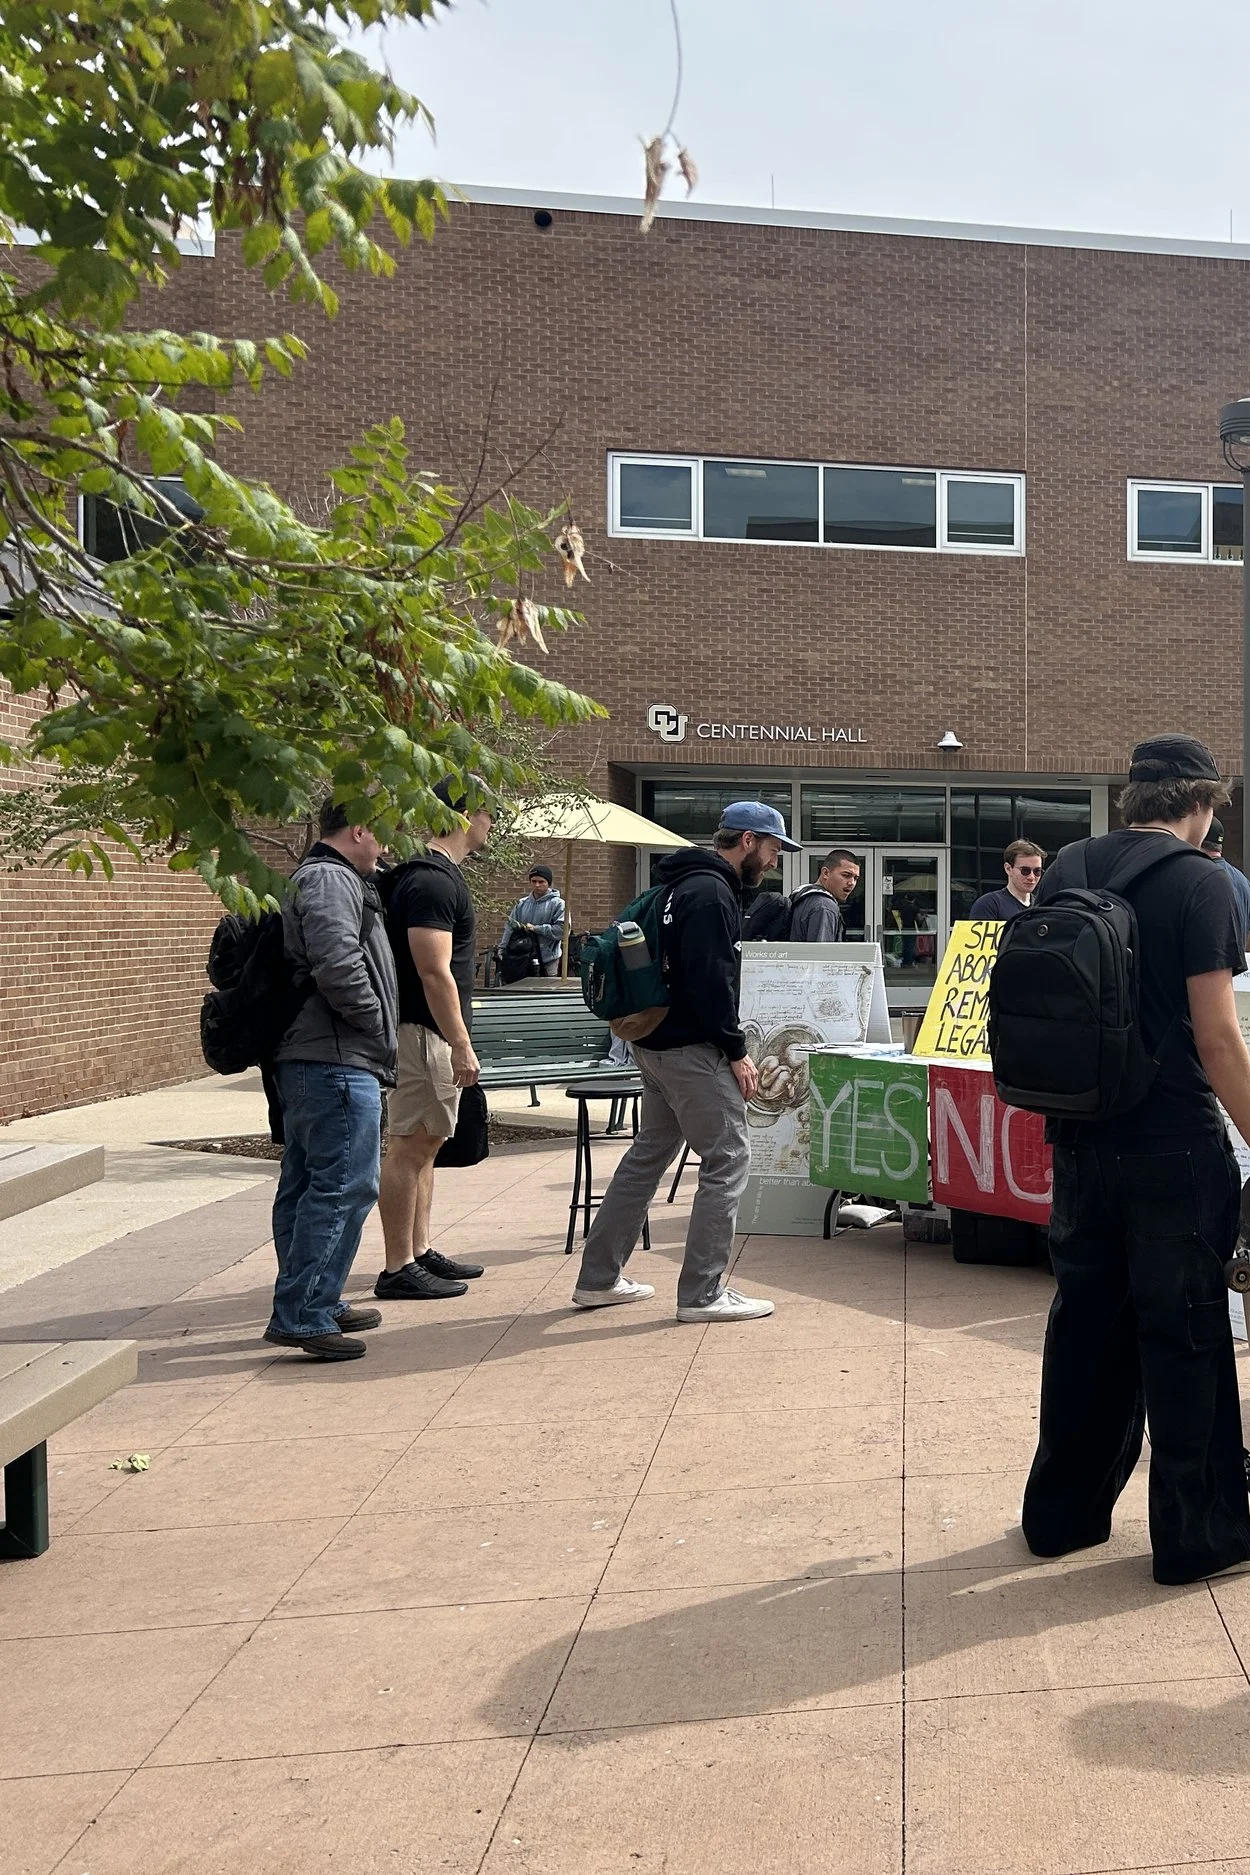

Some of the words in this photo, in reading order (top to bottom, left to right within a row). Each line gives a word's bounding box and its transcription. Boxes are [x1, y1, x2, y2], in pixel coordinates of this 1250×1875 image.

[696, 723, 817, 741] CENTENNIAL
[822, 727, 868, 743] HALL
[745, 950, 768, 959] Works
[769, 950, 777, 959] of
[934, 1022, 990, 1056] LEGA
[809, 1078, 923, 1181] YES
[760, 1177, 781, 1185] better
[784, 1178, 800, 1187] than
